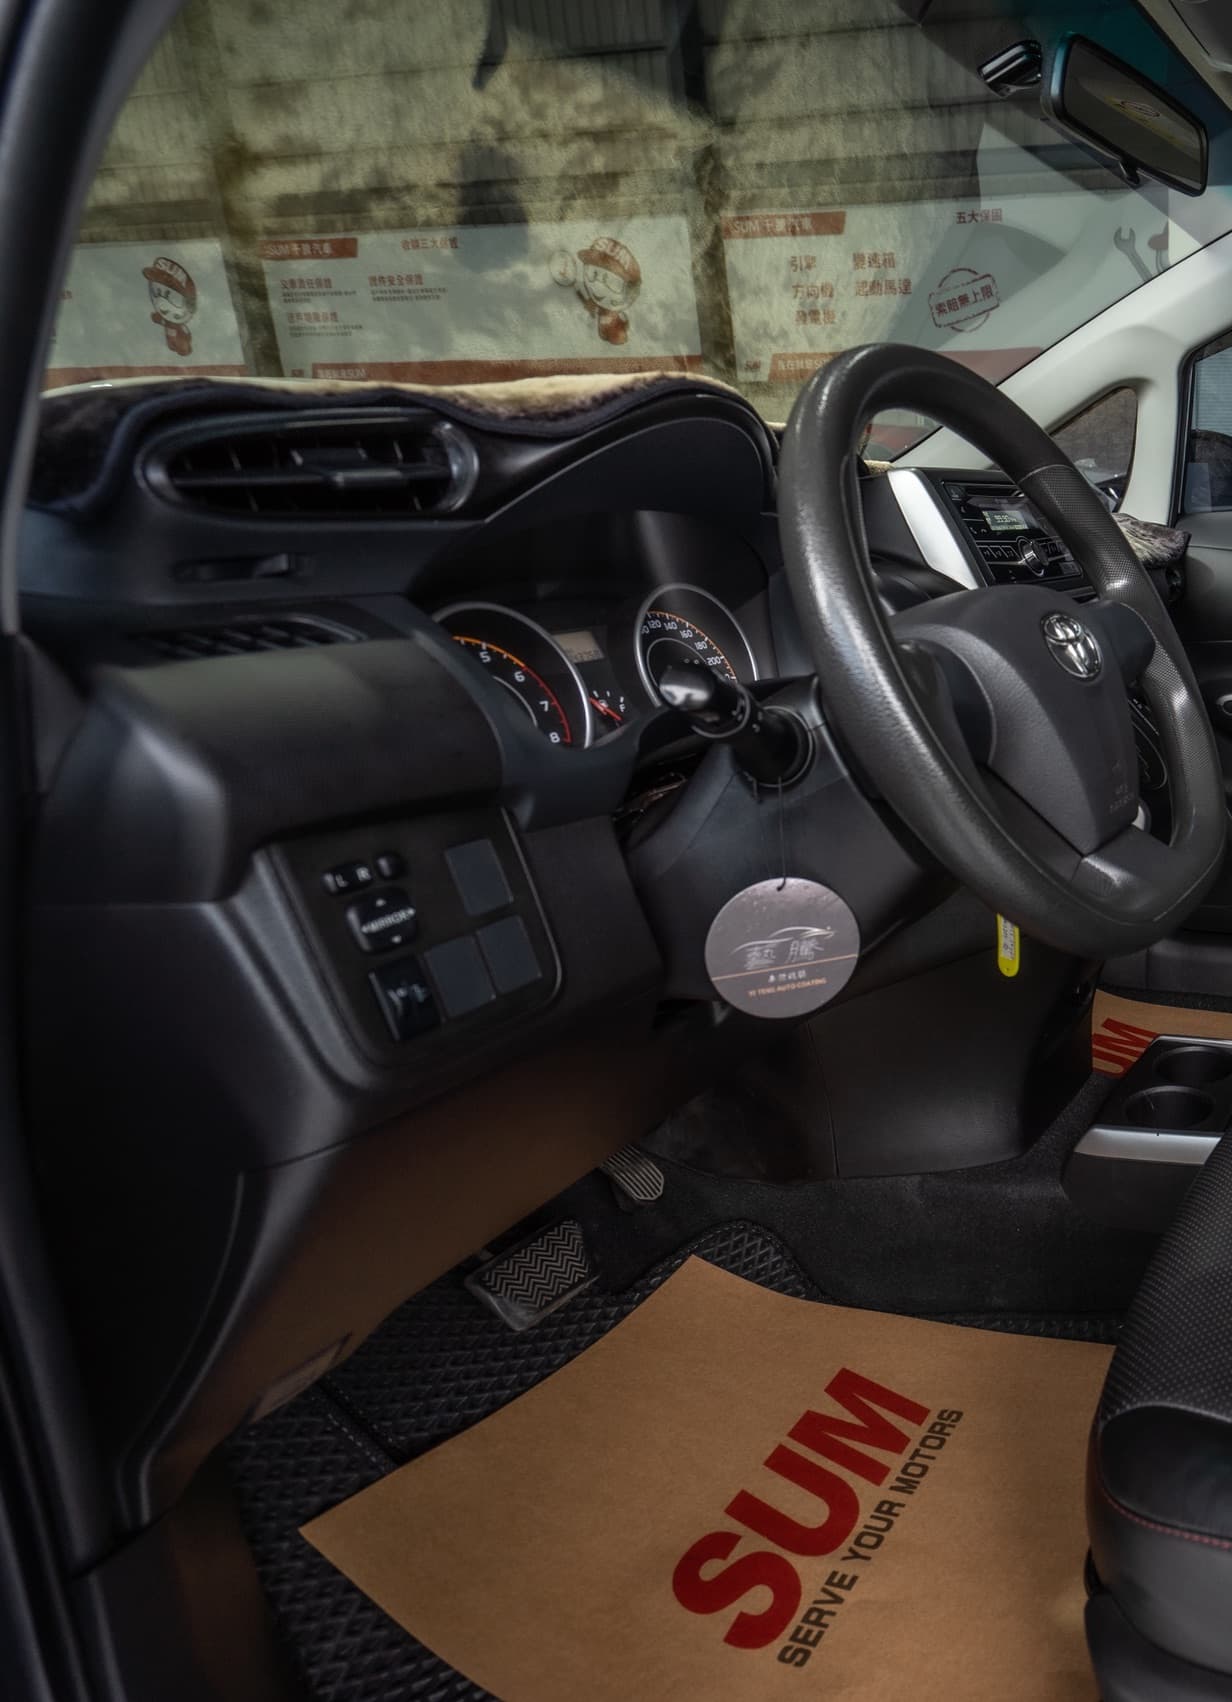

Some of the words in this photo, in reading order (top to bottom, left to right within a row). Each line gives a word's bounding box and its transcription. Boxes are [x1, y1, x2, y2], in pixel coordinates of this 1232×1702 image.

[663, 621, 678, 631] 140
[679, 629, 693, 639] 160
[694, 641, 708, 650] 180
[479, 651, 490, 663] 5
[706, 656, 721, 666] 200
[514, 670, 525, 682] 6
[539, 700, 549, 712] 7
[549, 731, 560, 743] 8
[672, 1367, 931, 1650] SUM
[777, 1570, 859, 1668] SERVE
[840, 1499, 906, 1562] YOUR
[889, 1408, 964, 1495] MOTORS
